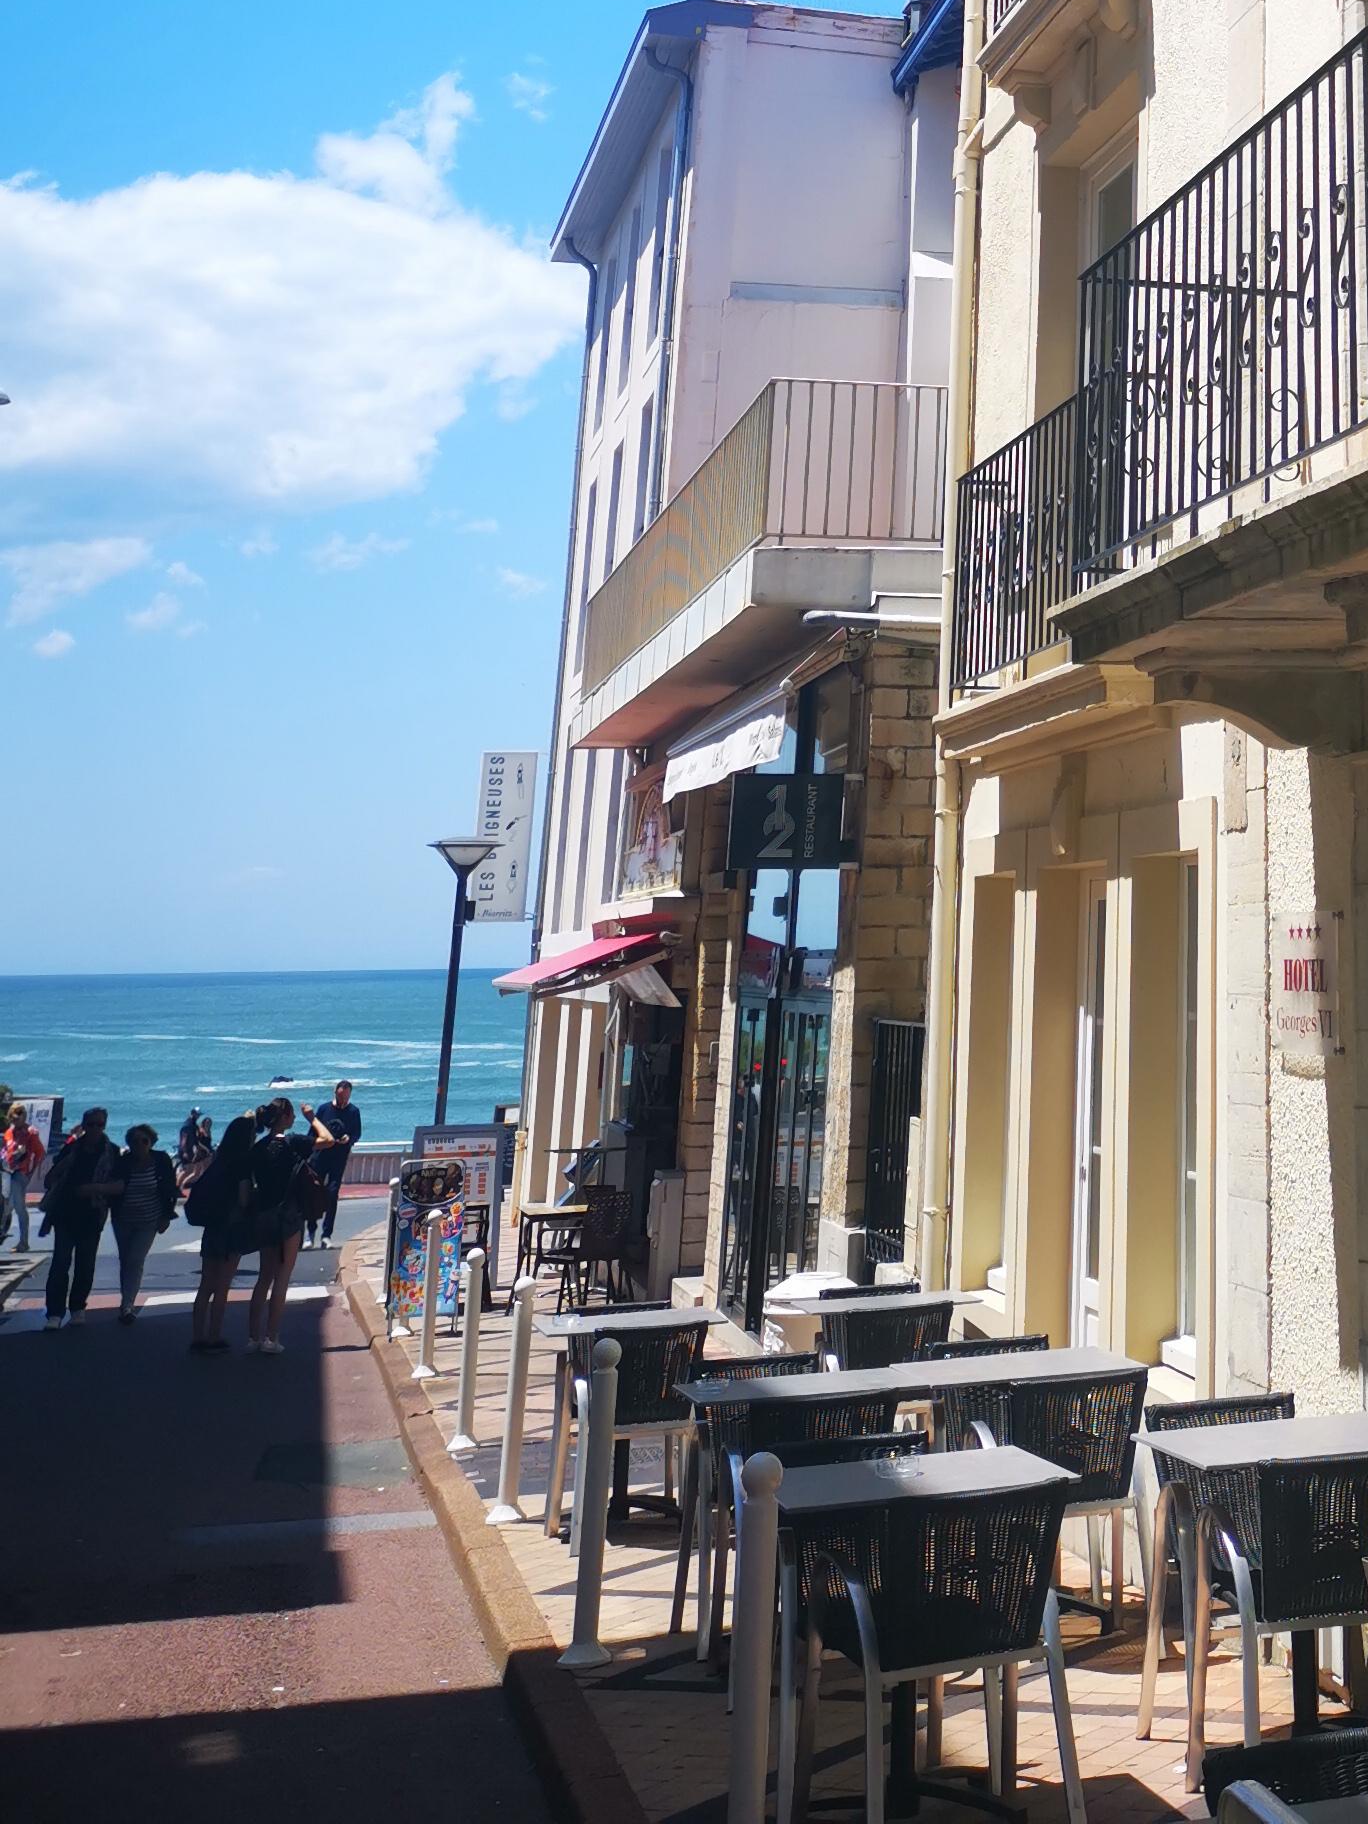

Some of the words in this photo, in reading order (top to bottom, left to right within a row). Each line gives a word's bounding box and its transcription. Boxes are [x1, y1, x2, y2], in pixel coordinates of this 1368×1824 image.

[484, 756, 505, 860] BIGNEUSES
[803, 783, 818, 858] RESTAURANT
[478, 871, 495, 901] LES
[1284, 958, 1328, 993] HOTEL
[1276, 1007, 1317, 1039] Georges
[1318, 1009, 1333, 1039] VI
